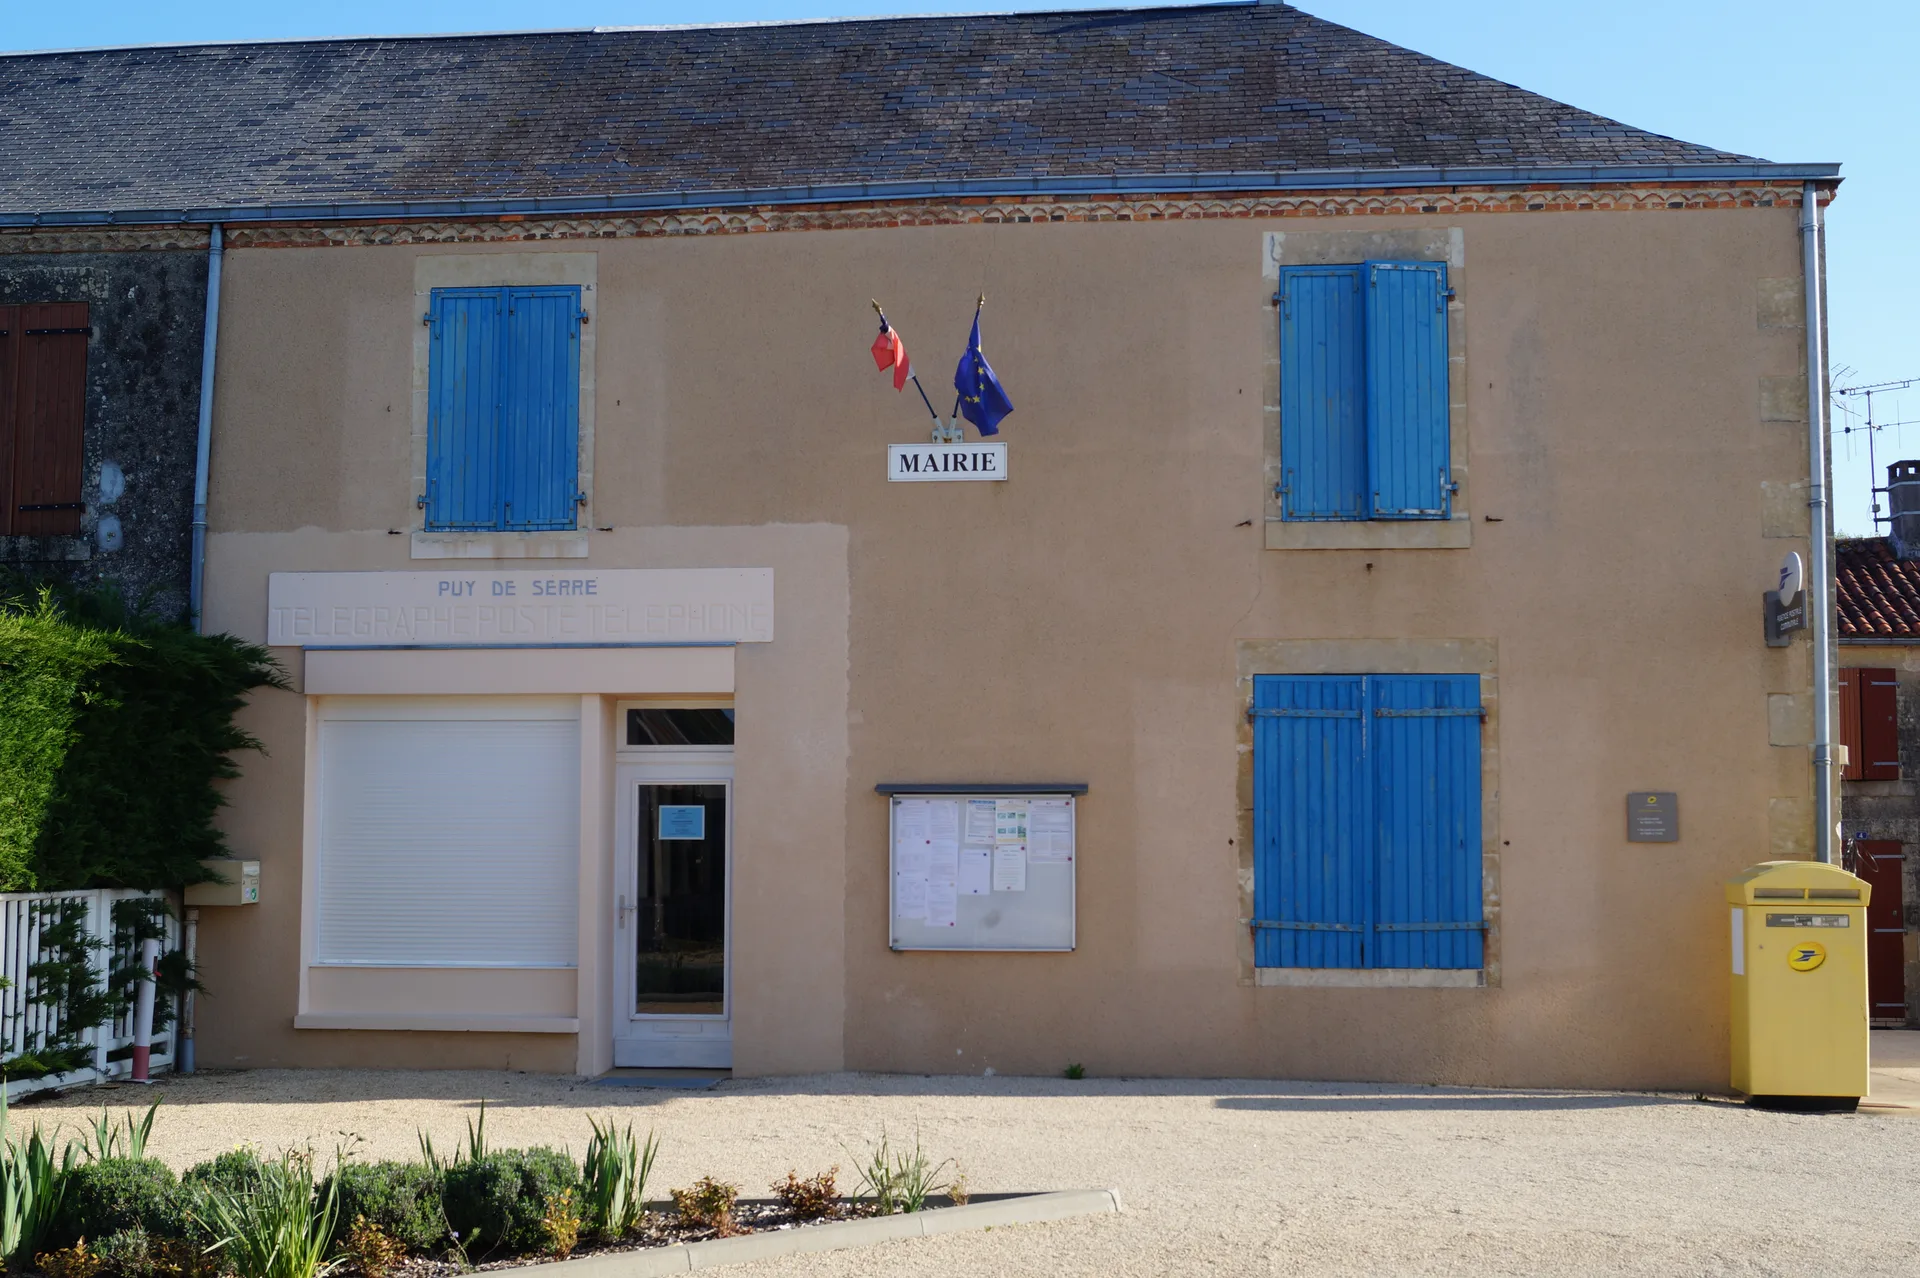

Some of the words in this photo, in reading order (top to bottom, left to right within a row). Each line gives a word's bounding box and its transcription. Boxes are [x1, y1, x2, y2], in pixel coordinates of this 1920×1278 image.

[899, 452, 996, 473] MAIRIE
[438, 580, 476, 597] PUY
[492, 580, 516, 596] DE
[532, 579, 598, 596] SERRE
[272, 606, 470, 637] TELEGRAPHE
[476, 604, 579, 635] POSTE
[585, 603, 768, 634] TELEPHONE
